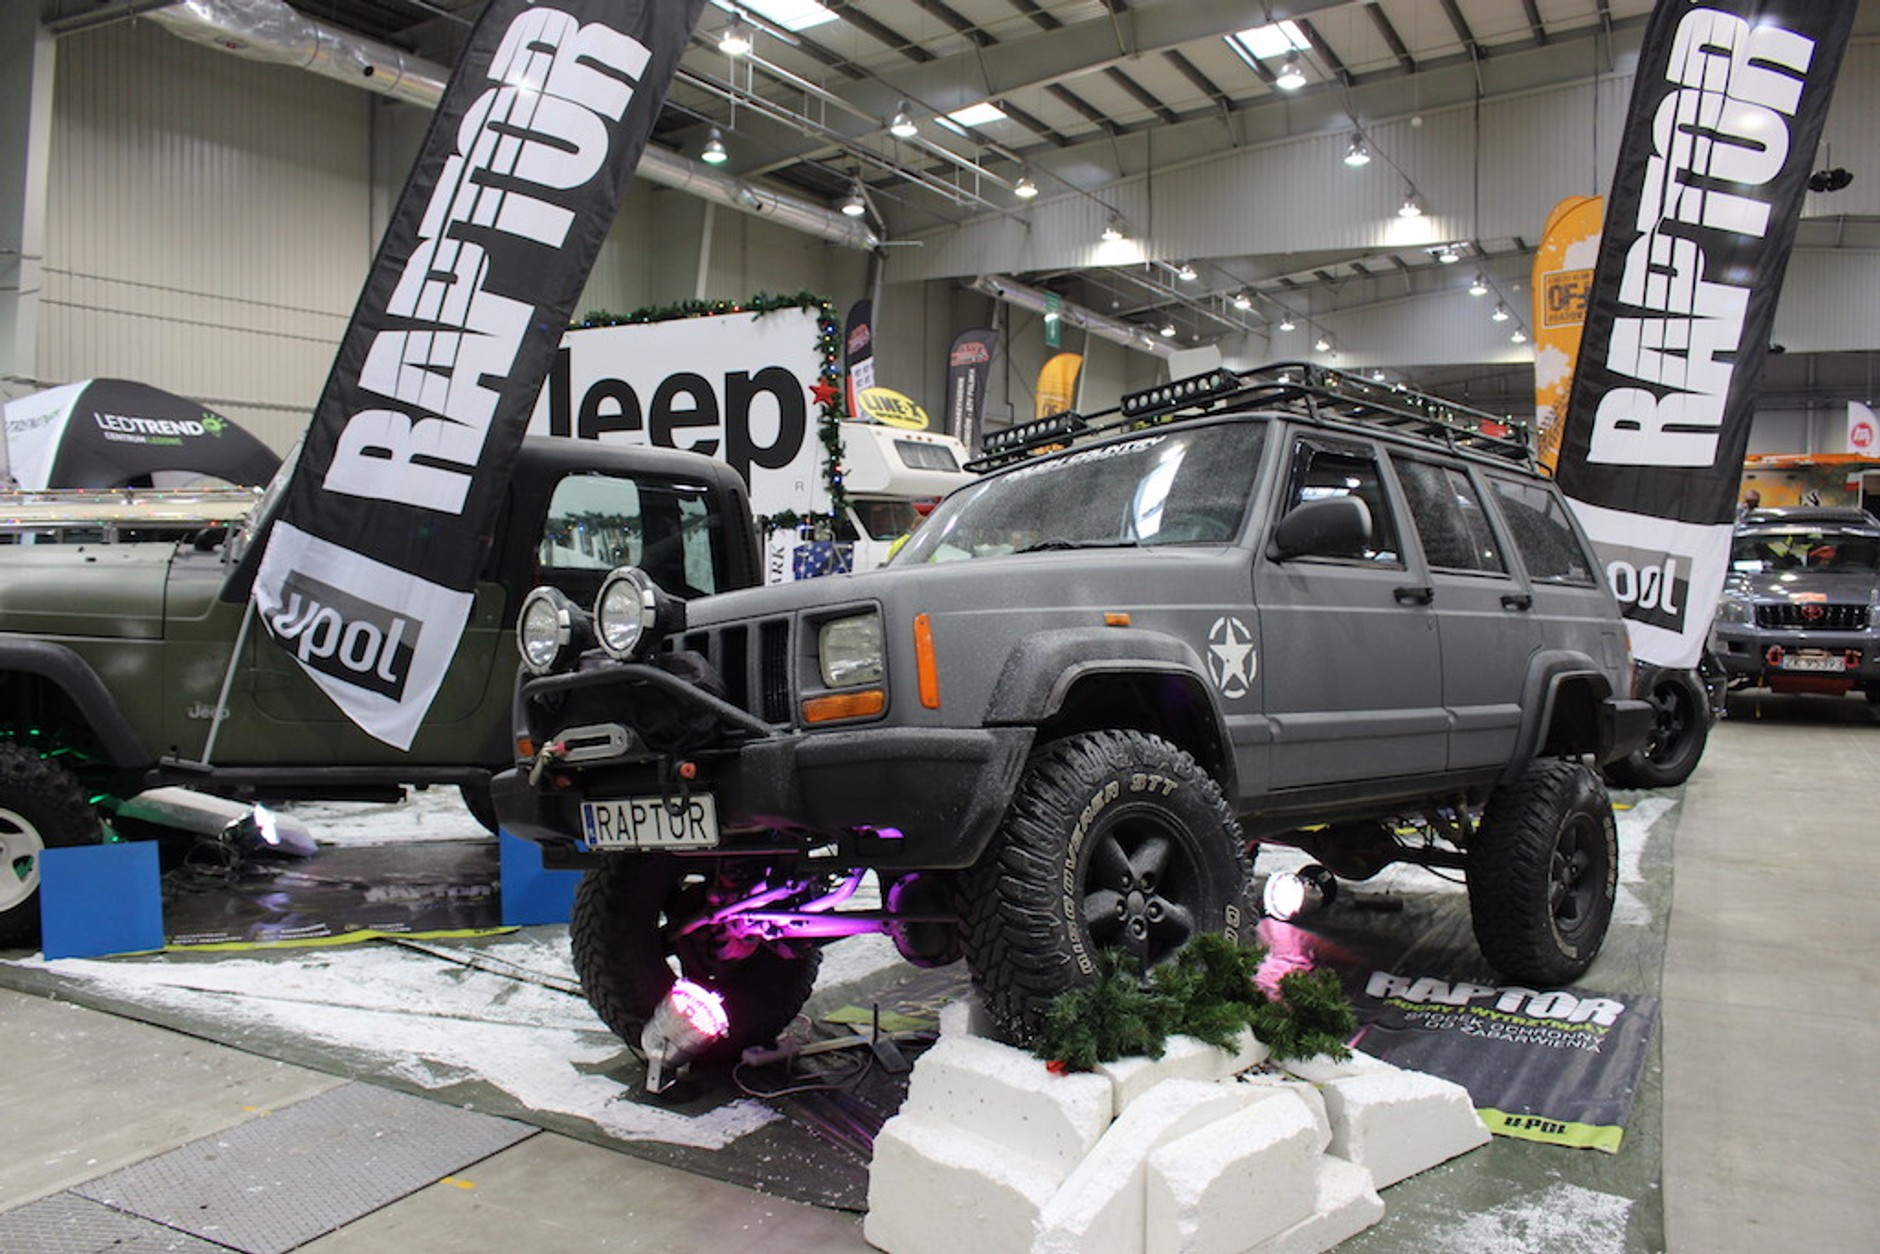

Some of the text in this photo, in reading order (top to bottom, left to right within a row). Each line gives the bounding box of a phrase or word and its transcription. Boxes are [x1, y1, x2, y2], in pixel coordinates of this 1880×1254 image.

[1587, 8, 1815, 466] RAPTOR
[323, 7, 652, 515] RAPTOR
[94, 412, 204, 436] LEDTREND
[1130, 773, 1178, 796] STT
[597, 801, 707, 841] RAPTOR
[1365, 971, 1625, 1026] RAPTOR
[1491, 1022, 1605, 1044] OCHRONNY
